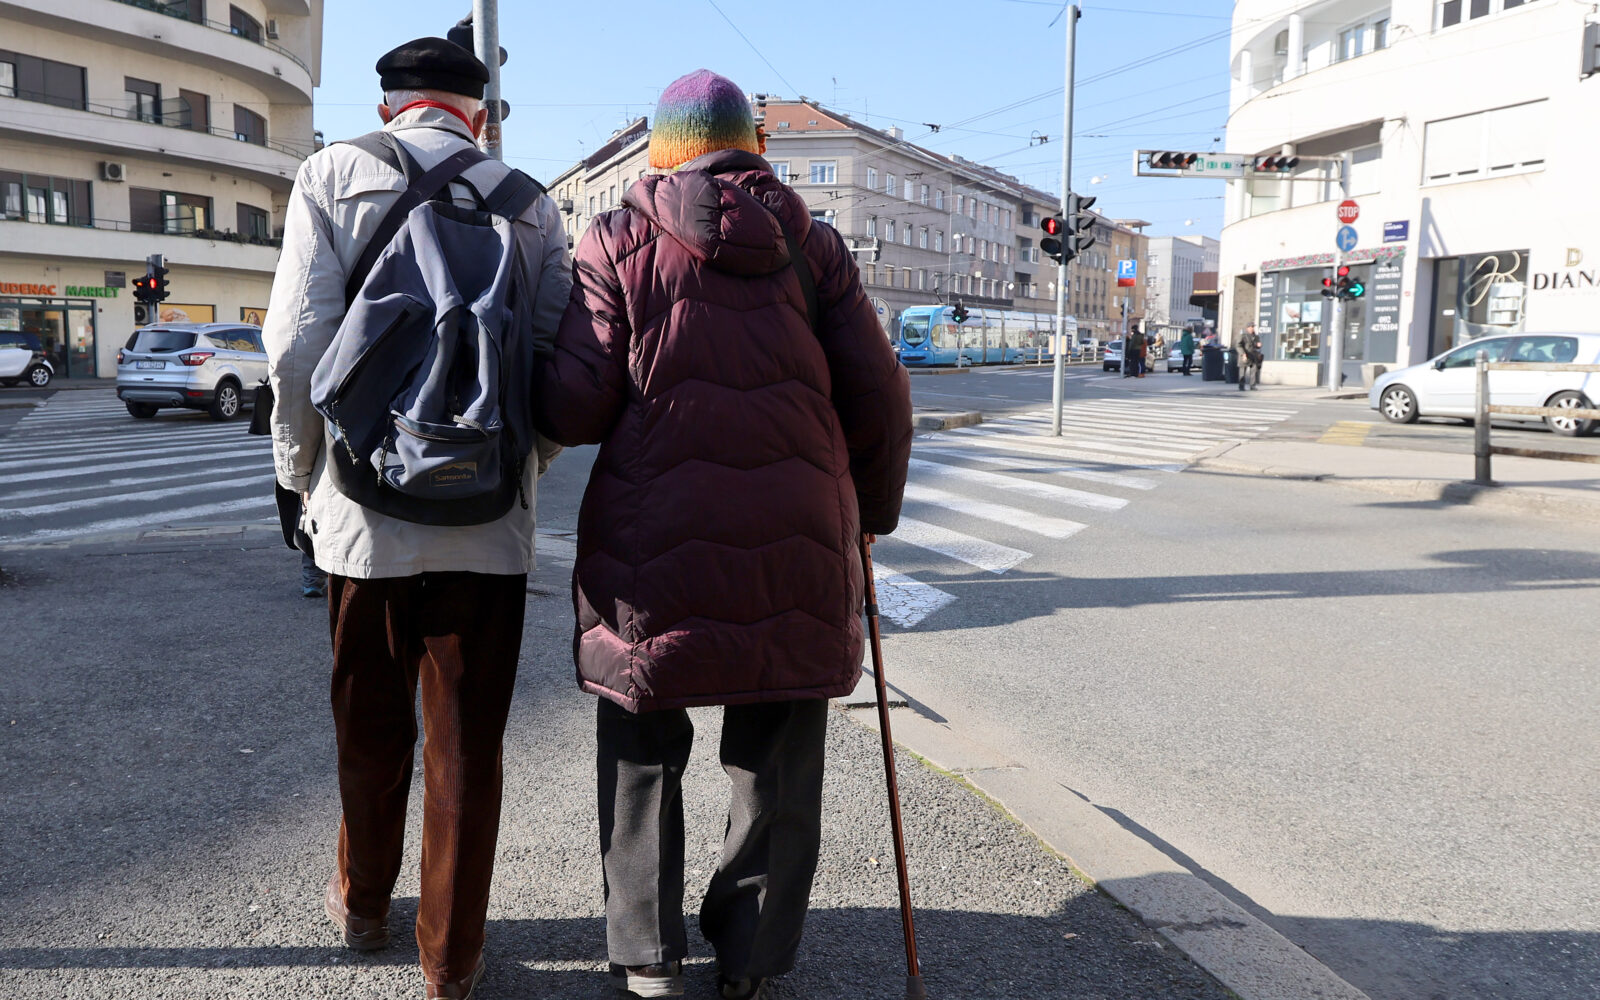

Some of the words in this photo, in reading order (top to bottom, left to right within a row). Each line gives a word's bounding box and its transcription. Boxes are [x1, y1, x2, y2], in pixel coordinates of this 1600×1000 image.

[1338, 206, 1359, 218] STOP
[1566, 248, 1583, 267] D
[1122, 261, 1133, 274] P
[1533, 270, 1600, 290] DIAN
[0, 281, 57, 296] UDENAC
[66, 285, 119, 298] MARKET
